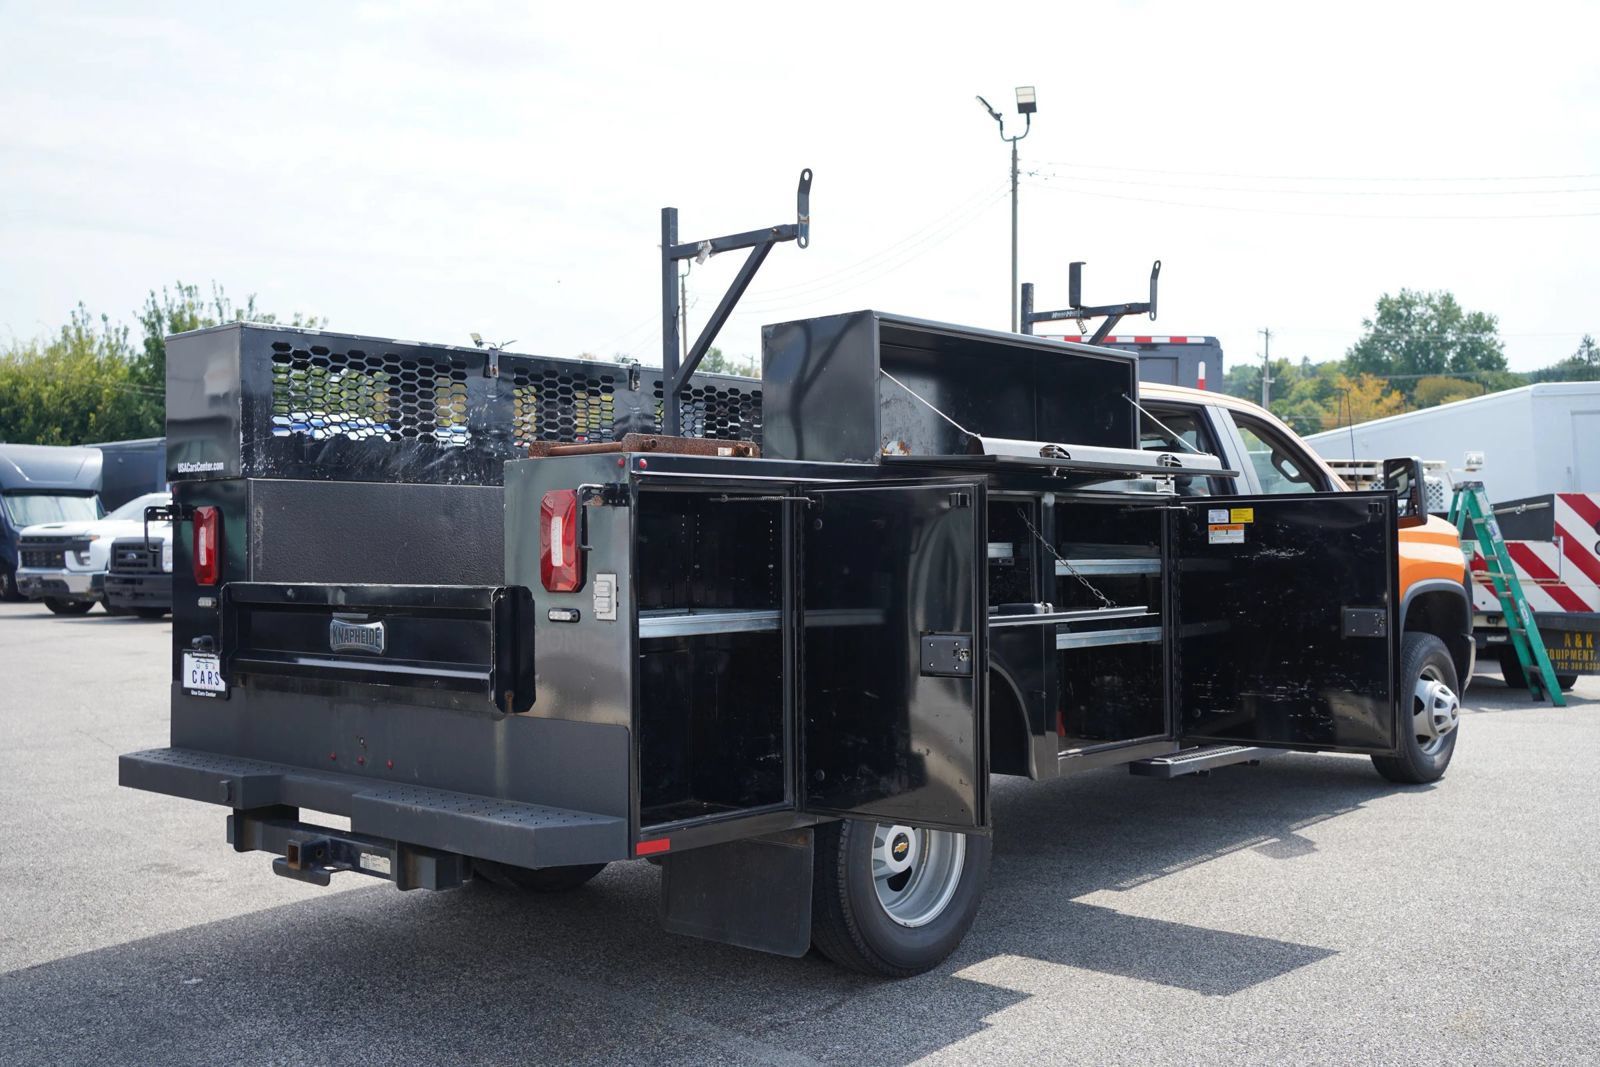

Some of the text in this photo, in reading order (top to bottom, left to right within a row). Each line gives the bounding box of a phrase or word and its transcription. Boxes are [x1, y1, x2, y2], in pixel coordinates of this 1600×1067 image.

[177, 462, 224, 473] USACarsCenter.com
[332, 625, 382, 648] KNAPHEIDE
[1564, 633, 1593, 648] A & K
[192, 669, 220, 686] CARS
